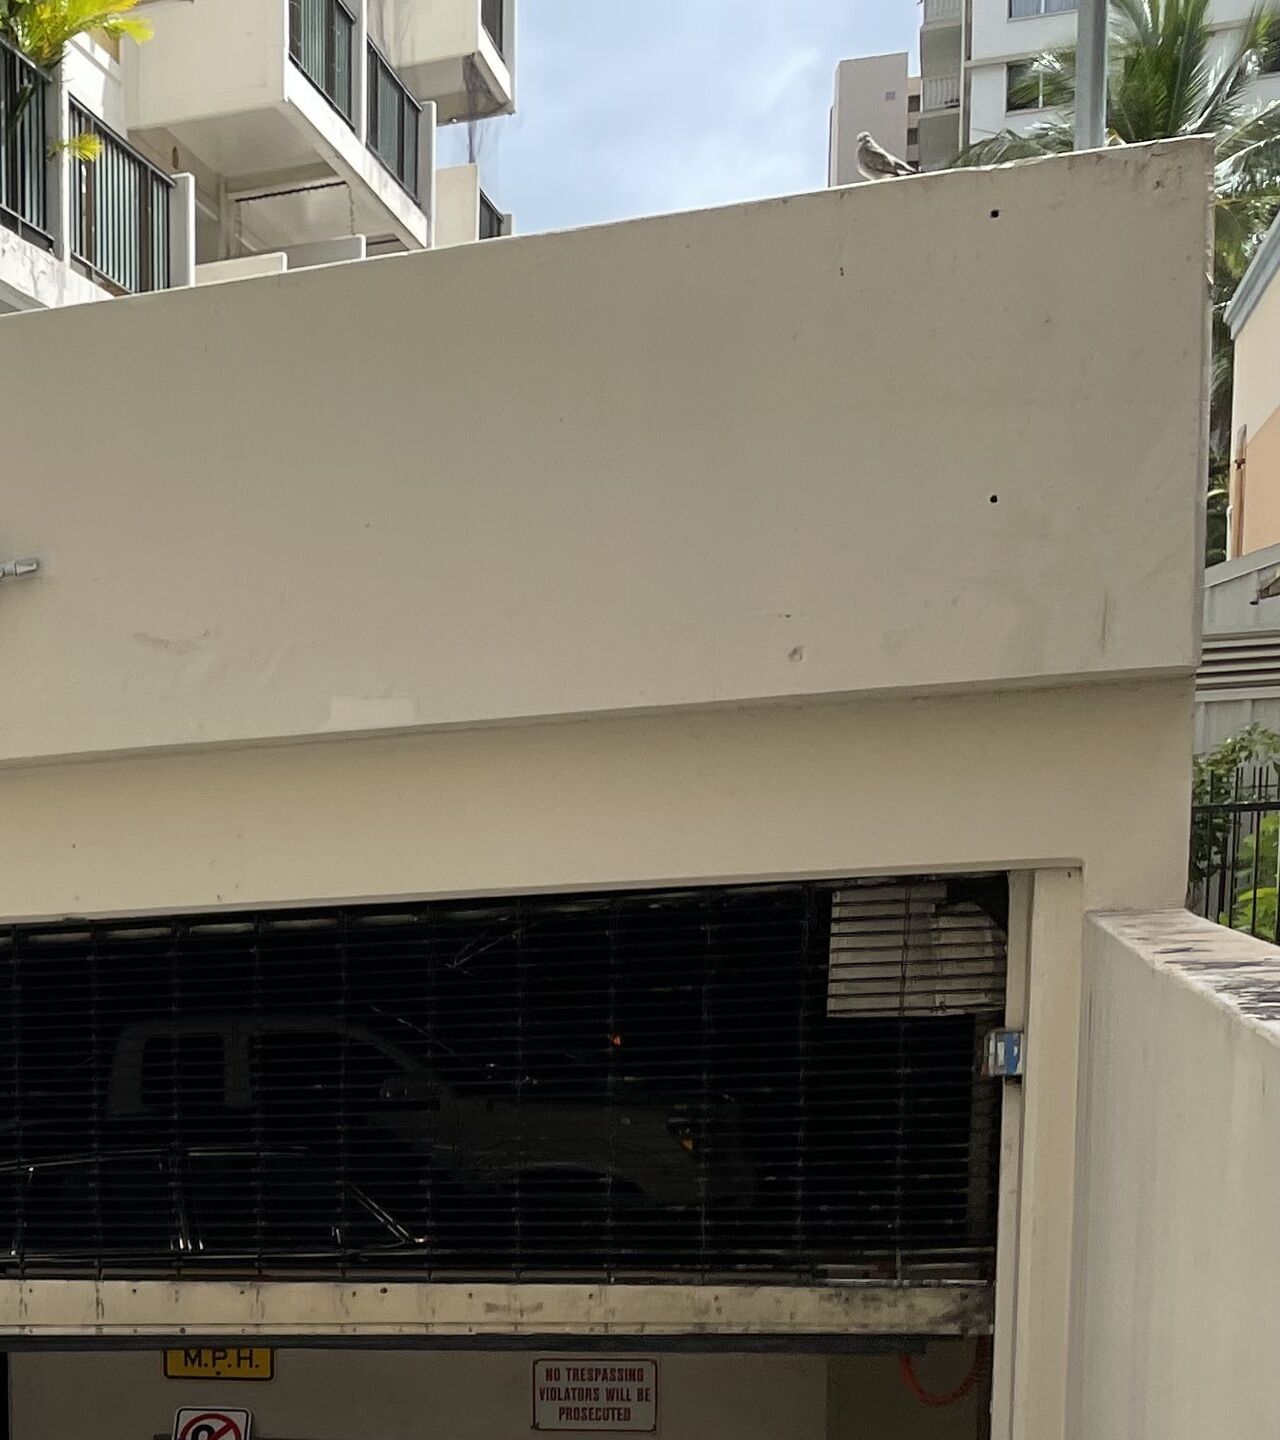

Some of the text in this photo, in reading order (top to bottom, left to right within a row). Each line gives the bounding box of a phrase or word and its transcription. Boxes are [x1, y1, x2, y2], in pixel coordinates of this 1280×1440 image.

[545, 1367, 644, 1382] NO TRESPASSING
[539, 1387, 651, 1402] VIOLATORS WILL BE
[558, 1407, 631, 1421] PROSECUTED
